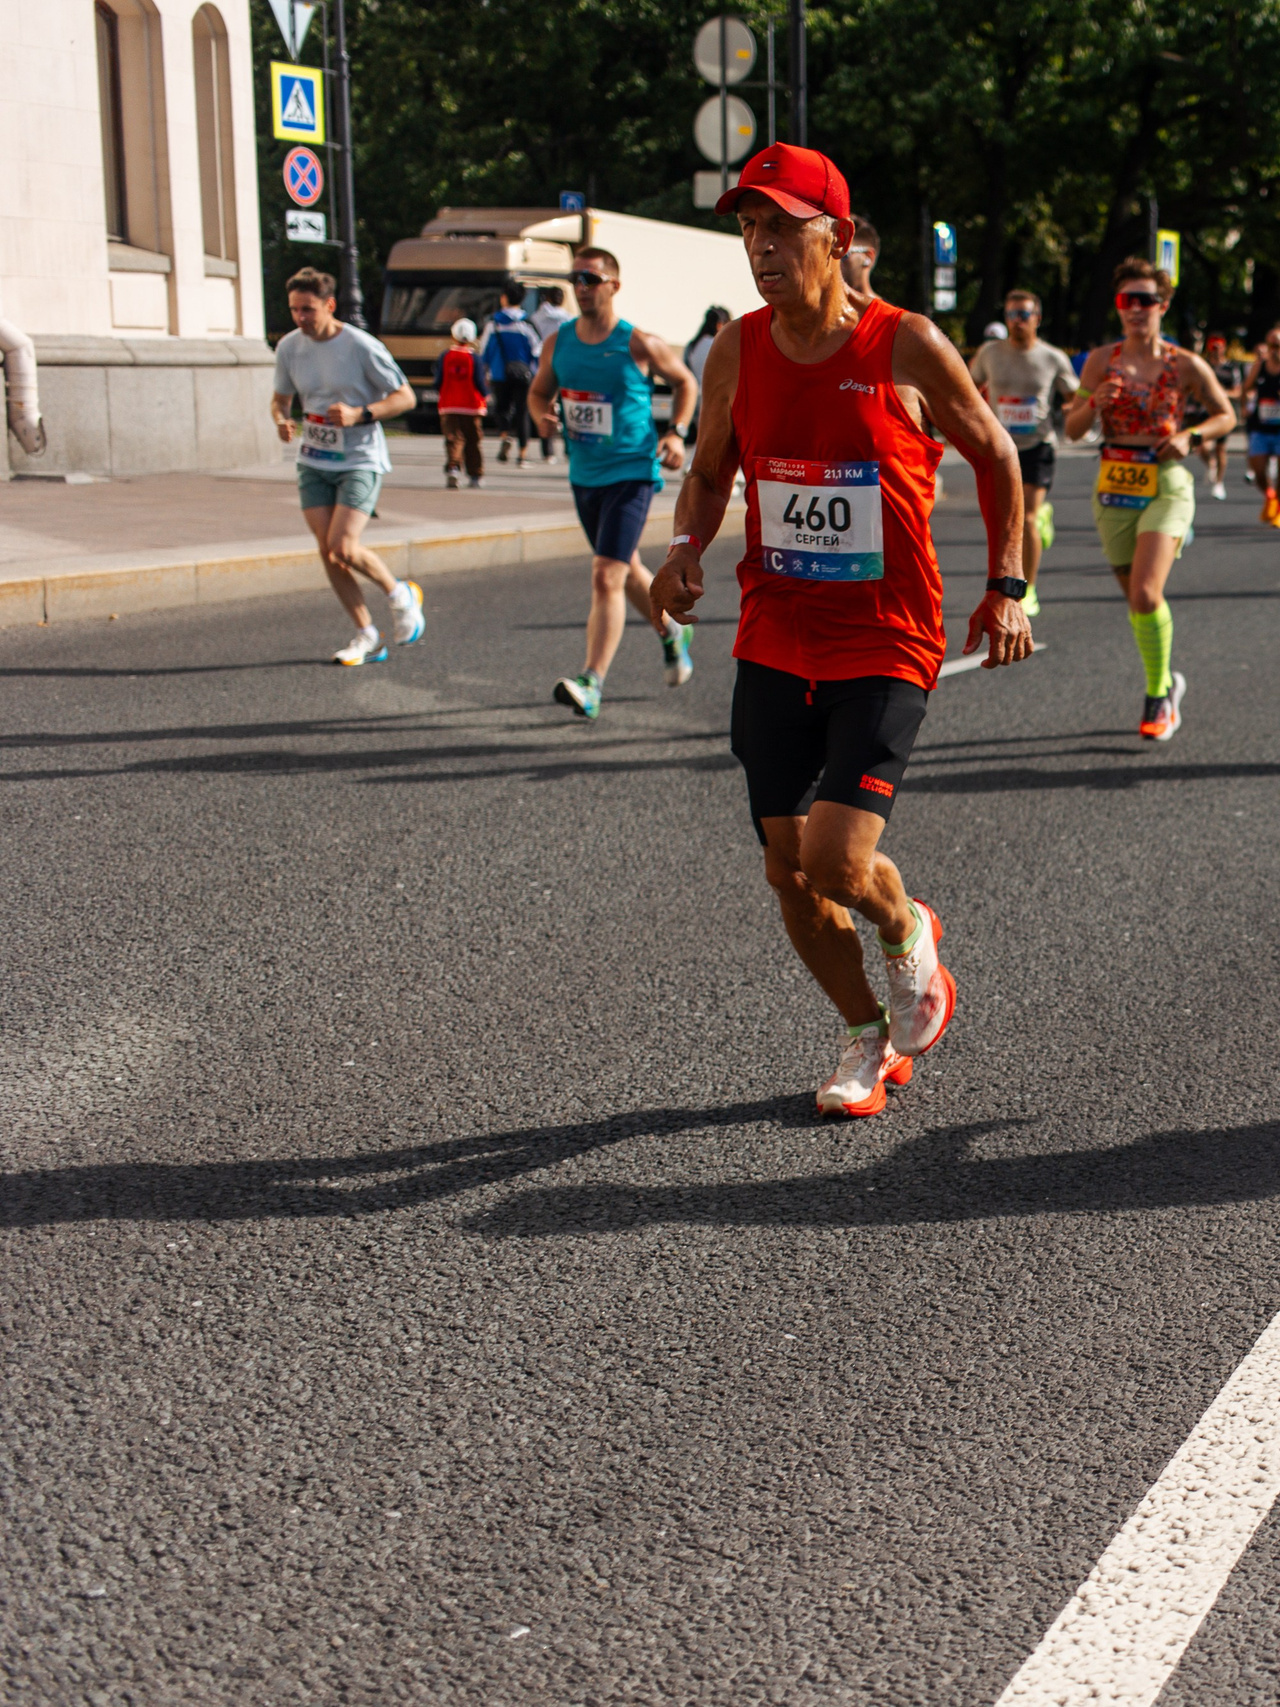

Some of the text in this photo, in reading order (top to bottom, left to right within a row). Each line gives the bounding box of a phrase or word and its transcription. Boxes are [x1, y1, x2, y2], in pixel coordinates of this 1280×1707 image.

[770, 467, 805, 477] МАРАФОН
[824, 468, 842, 479] 21,1
[1106, 465, 1149, 486] 4336
[784, 494, 851, 532] 460
[795, 533, 840, 546] СЕРГЕЙ
